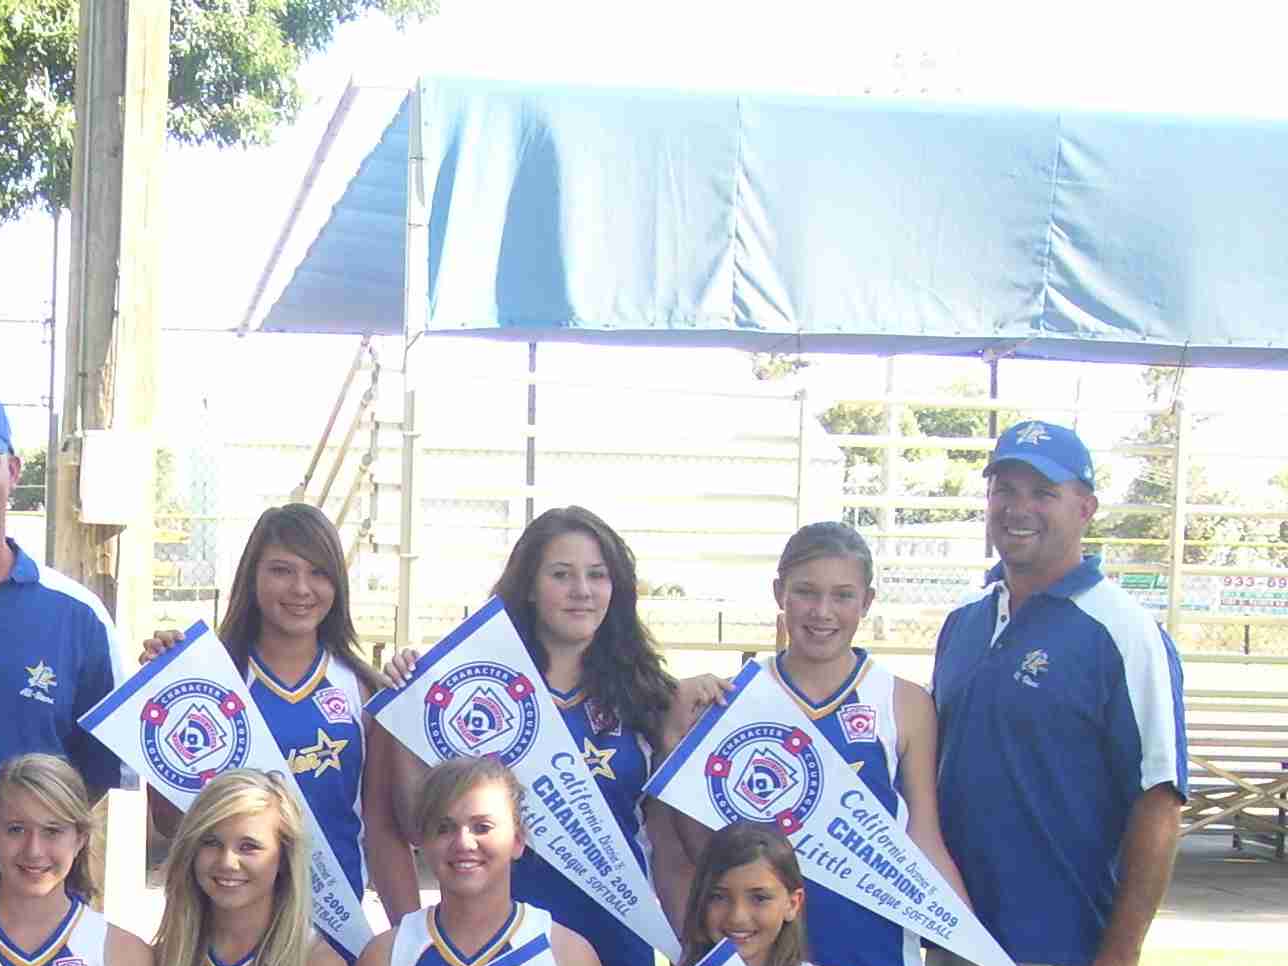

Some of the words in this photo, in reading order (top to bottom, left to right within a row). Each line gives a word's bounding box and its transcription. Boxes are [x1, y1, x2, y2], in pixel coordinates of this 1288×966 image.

[160, 683, 222, 704] CHARACTER
[445, 666, 510, 687] CHARACTER
[146, 738, 186, 784] LOYALTY
[721, 726, 783, 756] CHARACTER
[551, 751, 604, 834] California
[798, 753, 819, 815] COURAGE
[530, 772, 613, 877] CHAMPIONS
[609, 874, 639, 906] 2009
[837, 789, 907, 864] California
[547, 834, 588, 877] League
[584, 874, 631, 917] SOFTBALL
[790, 832, 852, 880] Little
[855, 872, 902, 910] League
[901, 905, 954, 940] SOFTBALL
[825, 815, 927, 906] CHAMPIONS
[925, 900, 959, 928] 2009
[323, 892, 351, 922] 2009
